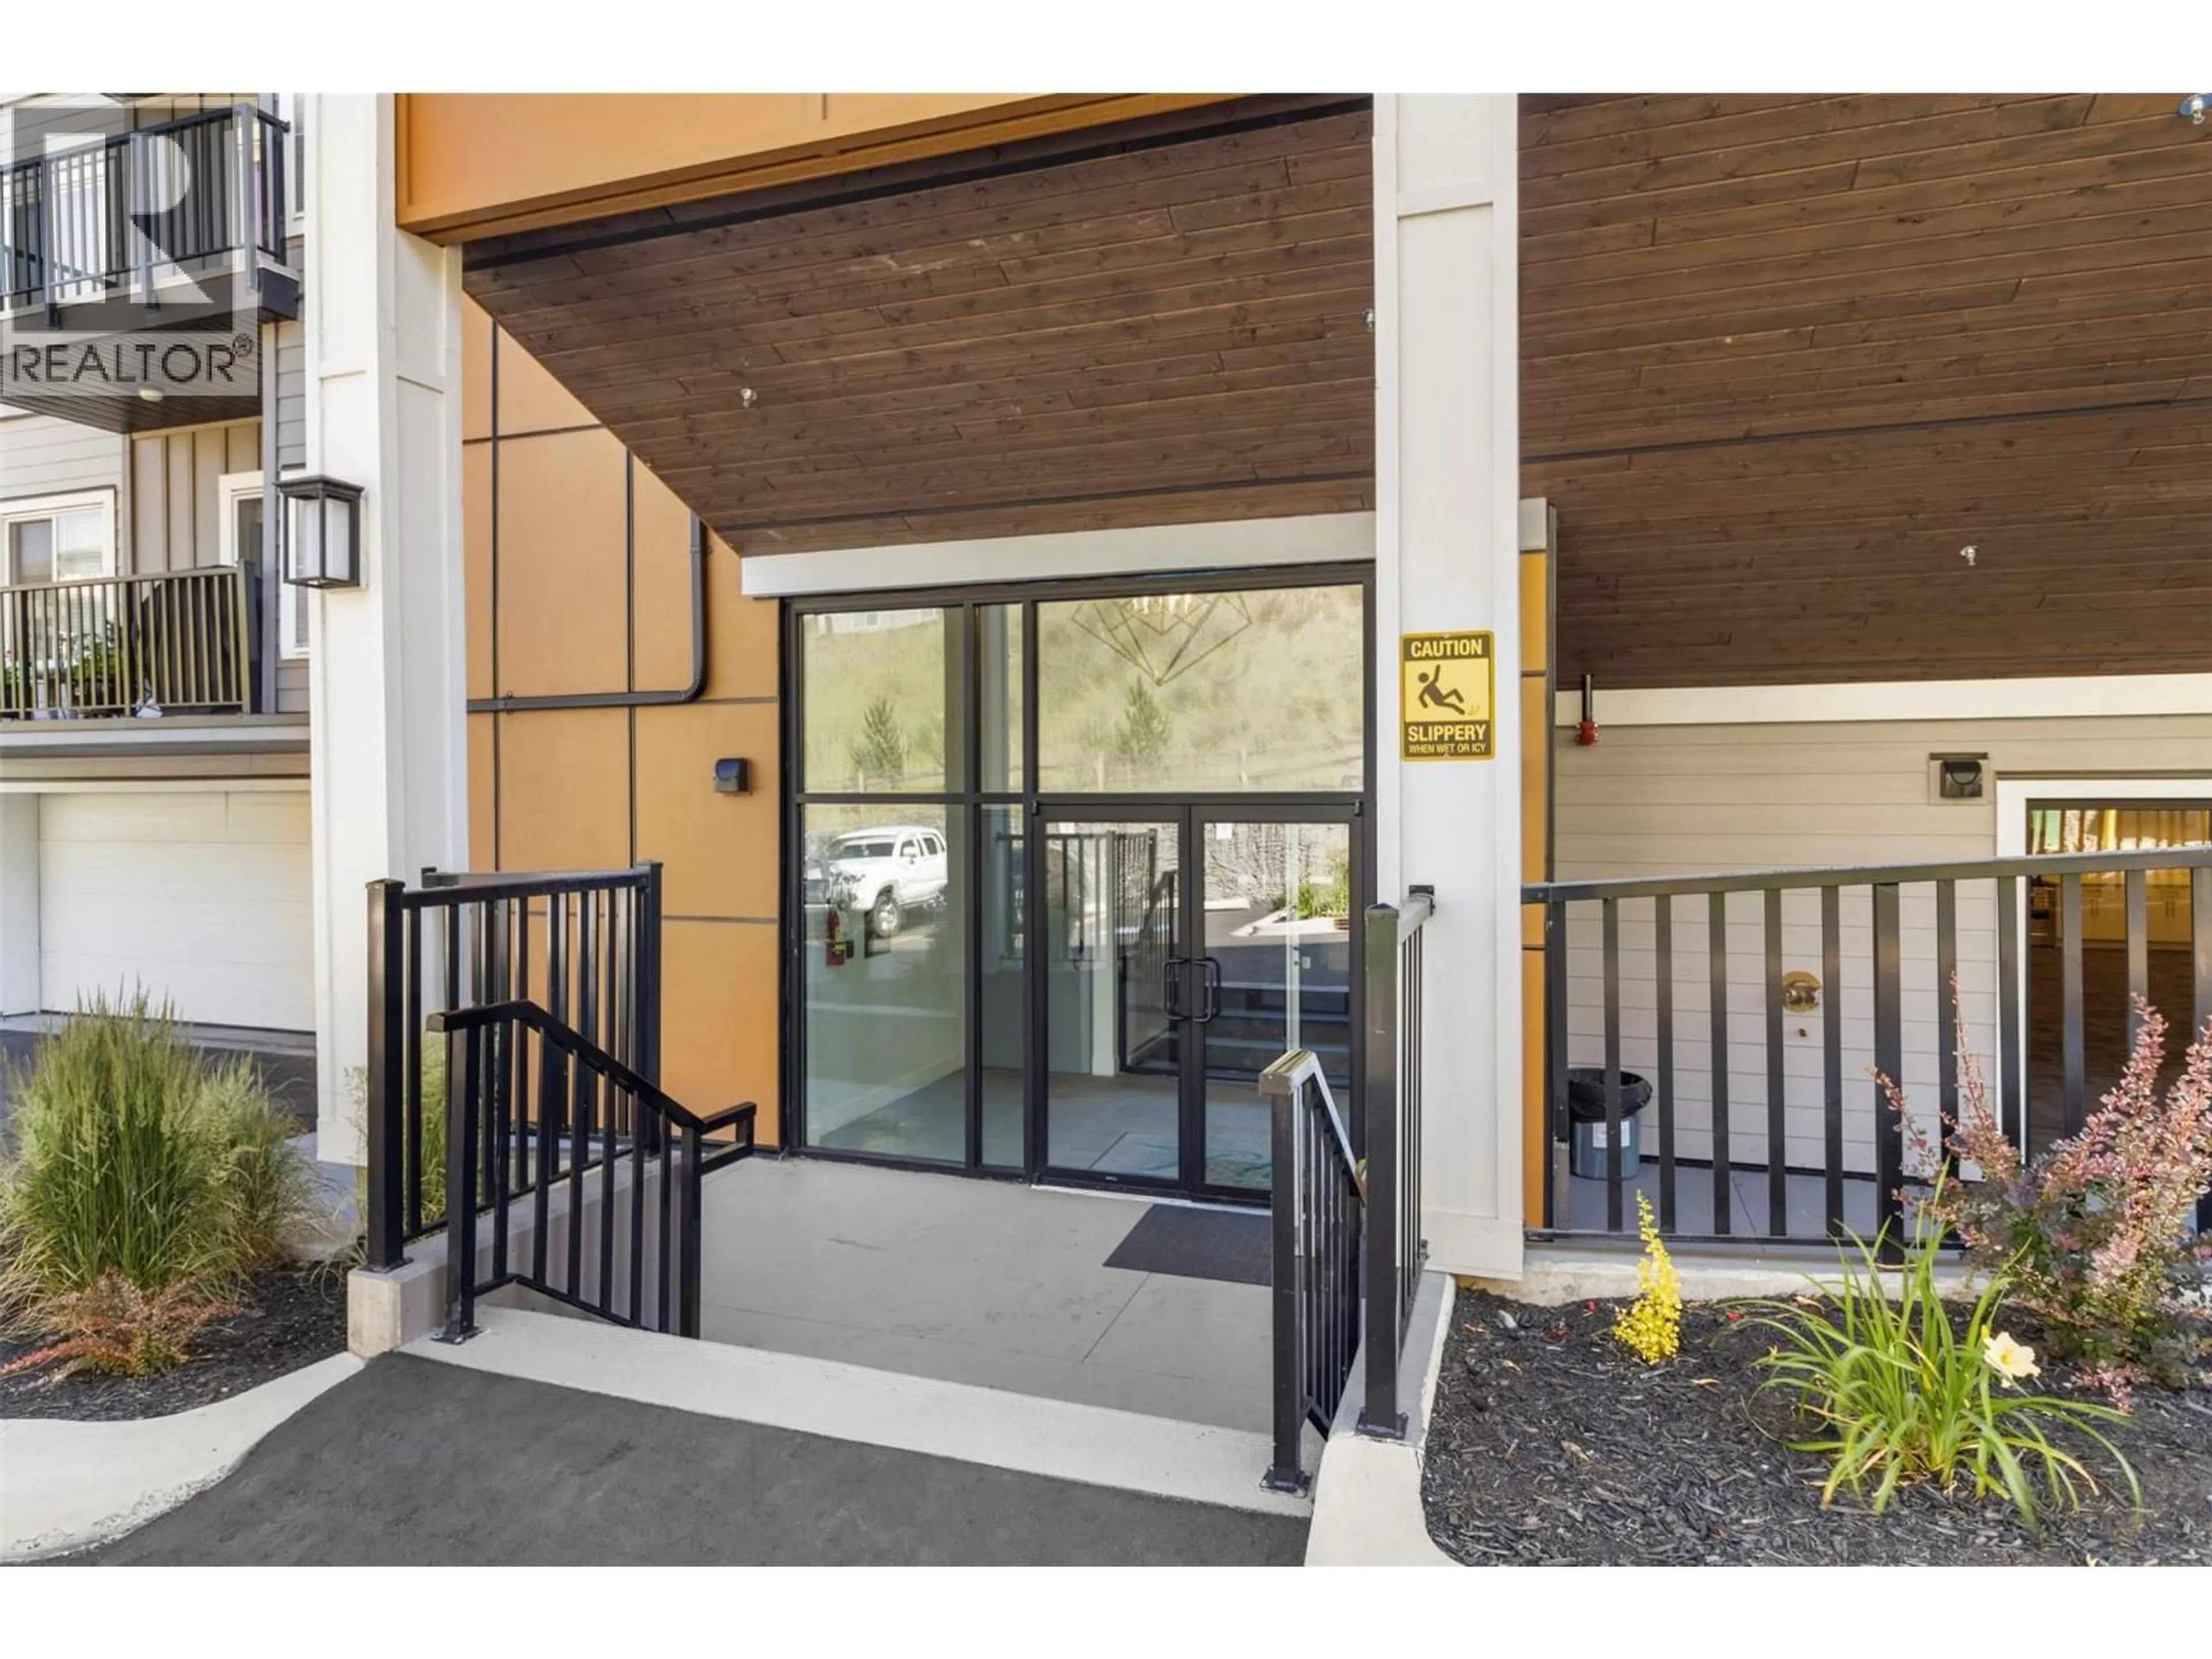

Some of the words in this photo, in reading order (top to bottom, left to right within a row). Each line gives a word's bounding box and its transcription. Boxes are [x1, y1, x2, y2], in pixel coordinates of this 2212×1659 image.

[1411, 639, 1482, 657] CAUTION
[1408, 724, 1486, 742] SLIPPERY
[1408, 743, 1434, 753] WHEN
[1437, 743, 1455, 753] WET
[1457, 743, 1470, 752] OR
[1472, 743, 1486, 752] ICY
